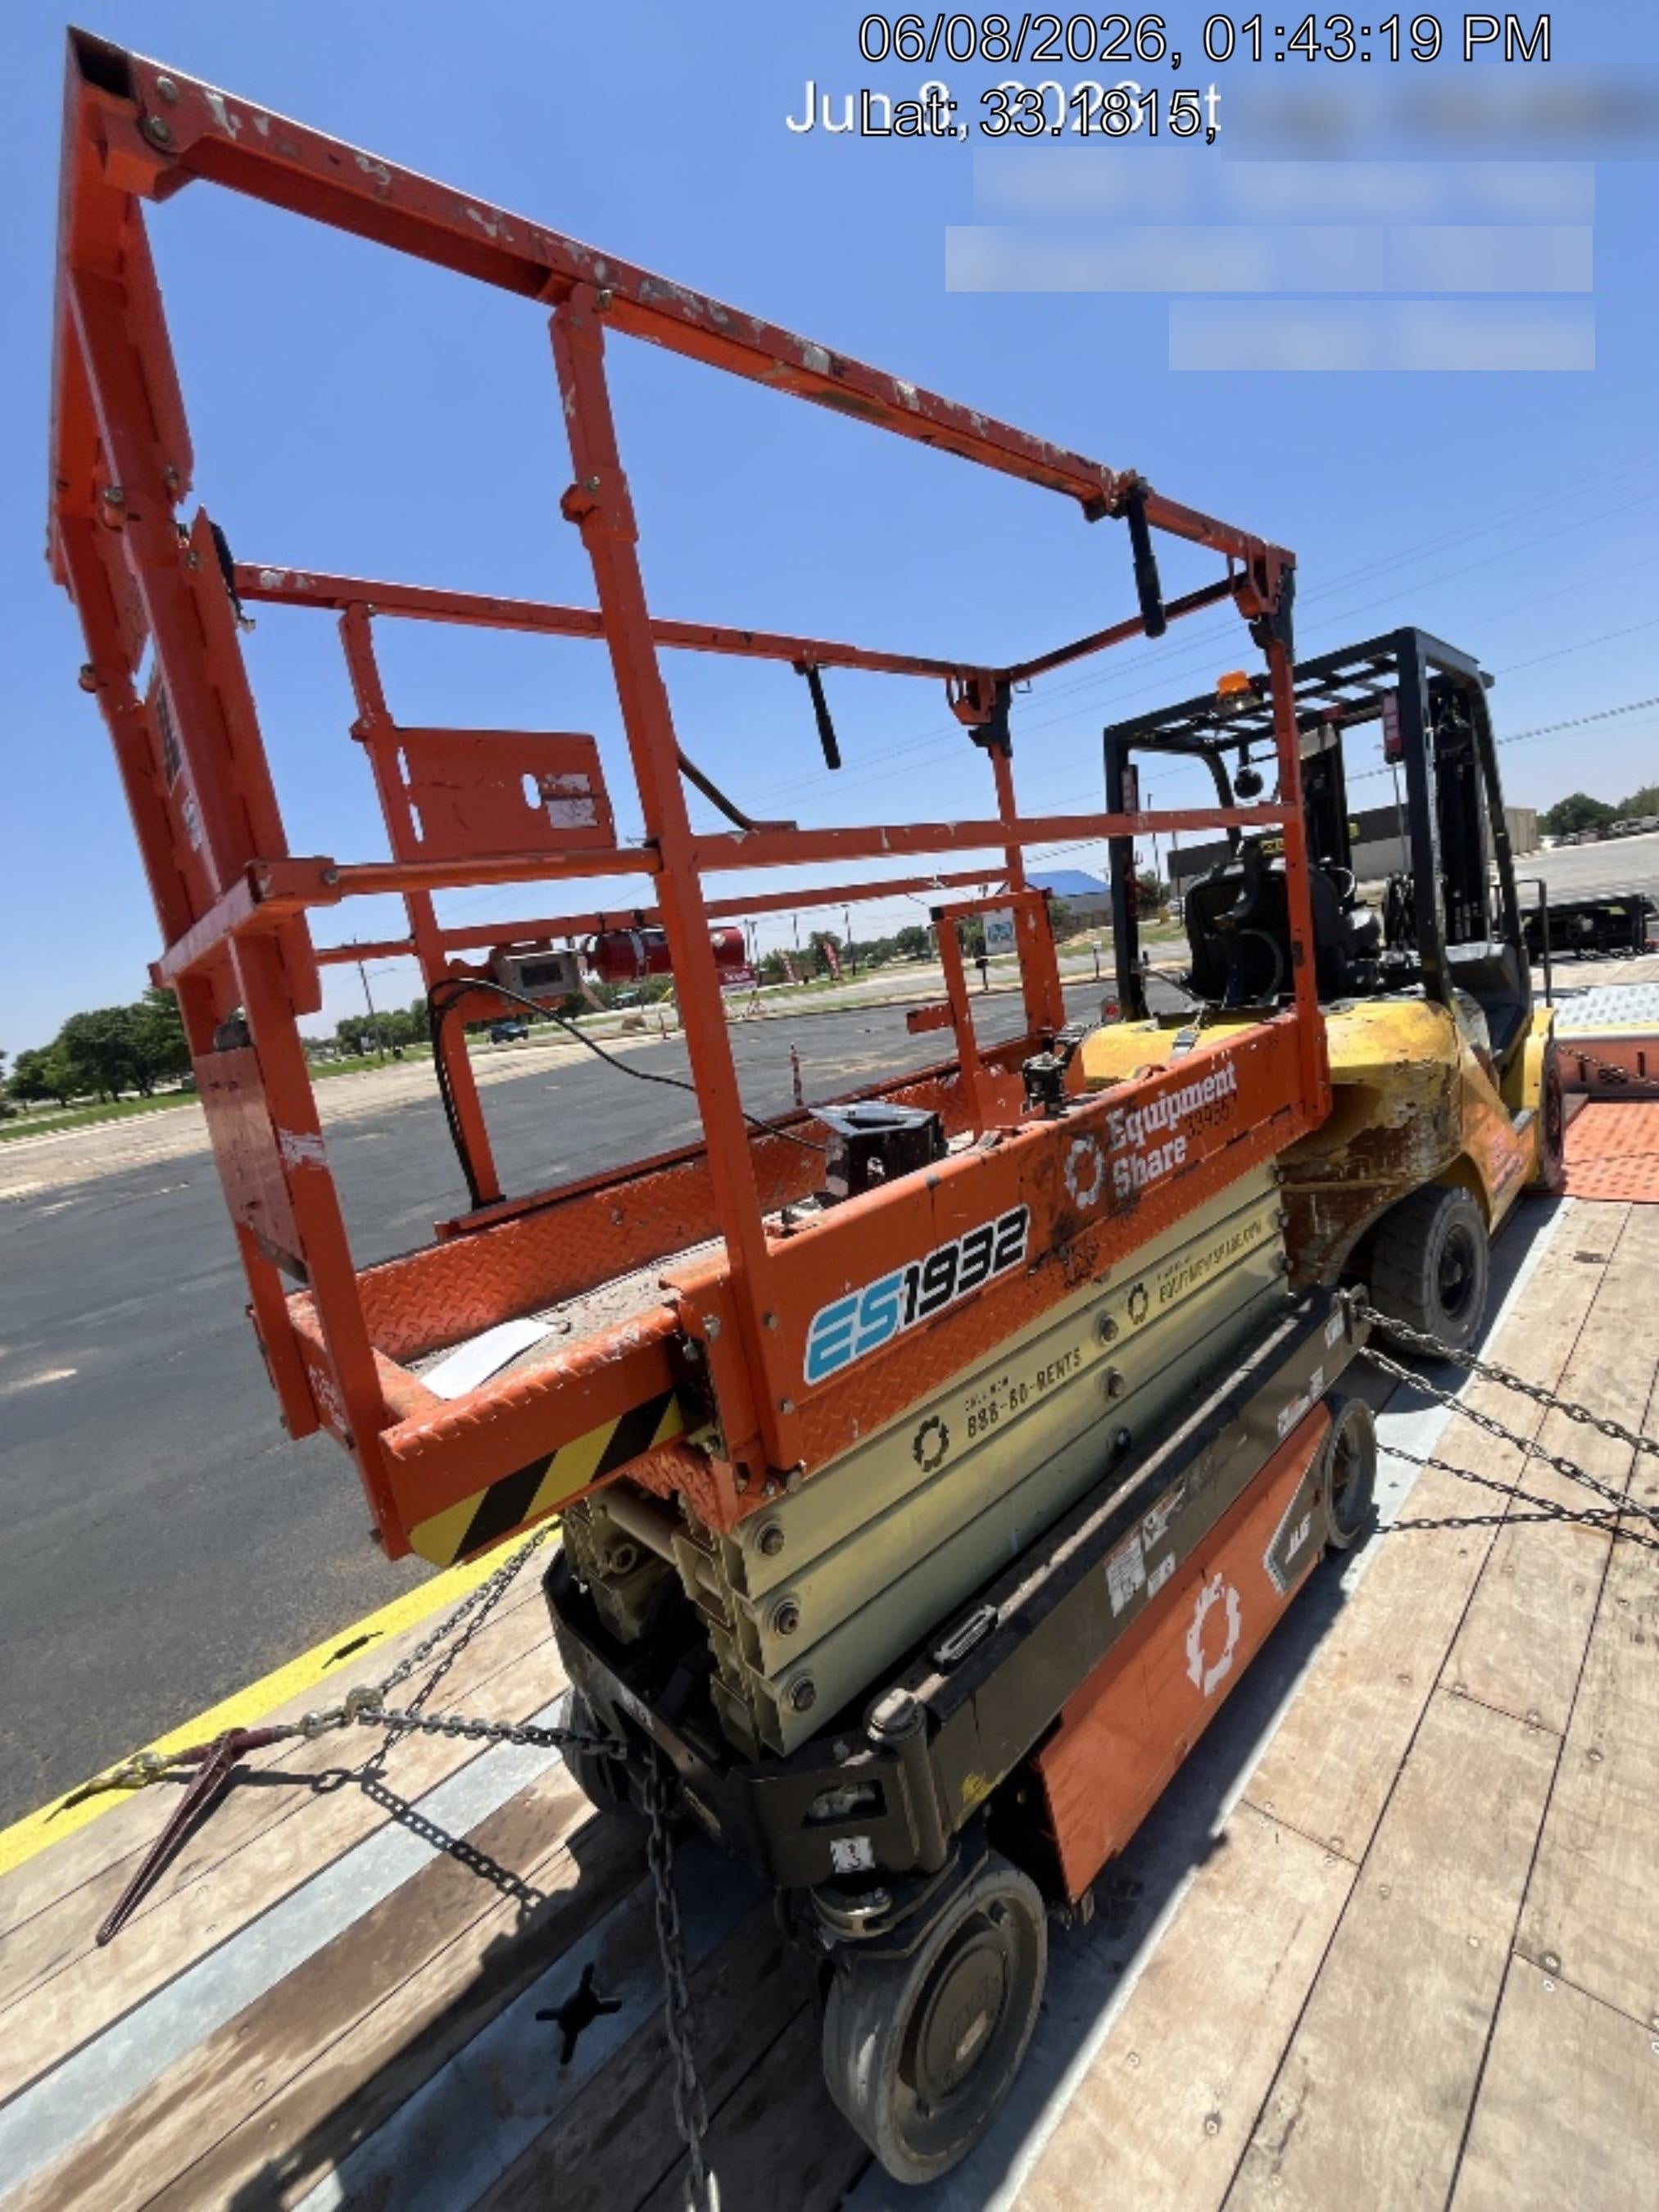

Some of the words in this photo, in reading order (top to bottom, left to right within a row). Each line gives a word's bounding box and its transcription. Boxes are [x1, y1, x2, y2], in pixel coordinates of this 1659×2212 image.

[1107, 1060, 1237, 1150] Equipment
[1113, 1135, 1186, 1199] Share
[804, 1203, 1031, 1385] ES1932
